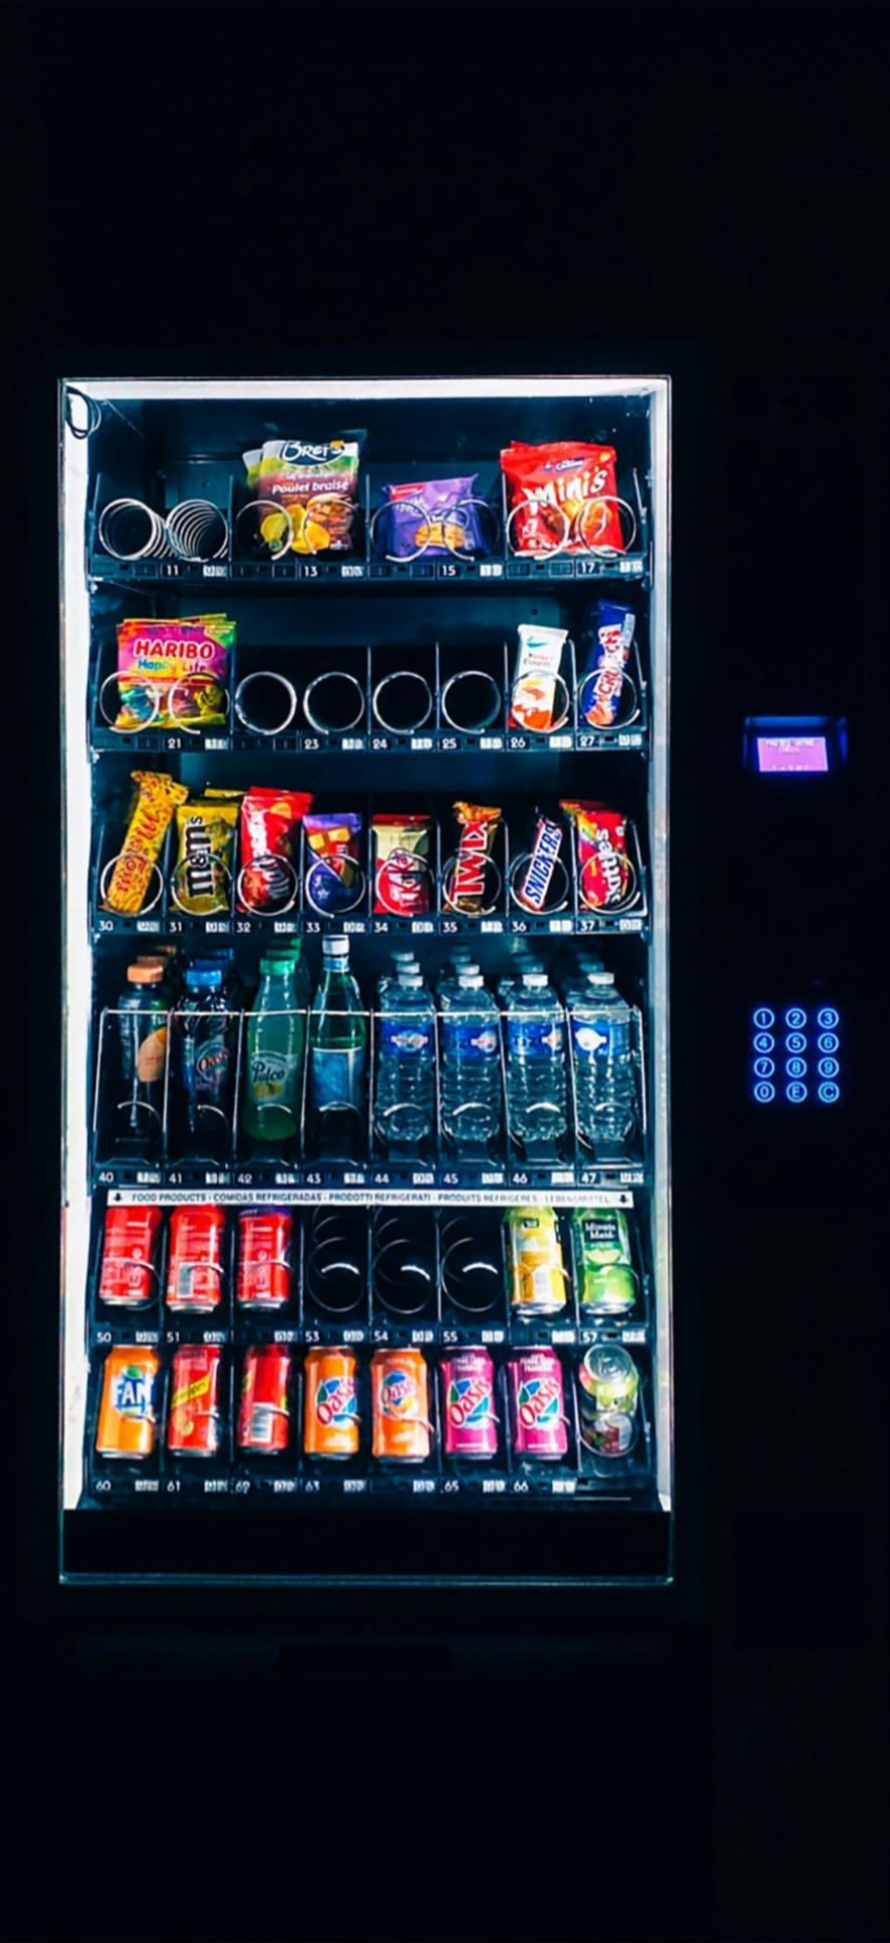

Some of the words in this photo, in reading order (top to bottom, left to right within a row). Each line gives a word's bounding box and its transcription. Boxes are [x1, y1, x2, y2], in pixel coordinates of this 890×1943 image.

[272, 482, 310, 495] Poulet
[167, 564, 179, 576] 11
[305, 565, 318, 577] 13
[443, 564, 456, 577] 15
[581, 560, 595, 574] 17
[134, 640, 215, 660] HARIBO
[138, 658, 176, 673] Happy
[168, 737, 181, 749] 21
[305, 738, 319, 750] 23
[373, 738, 388, 750] 24
[443, 737, 457, 750] 25
[511, 737, 526, 749] 26
[580, 735, 595, 748] 27
[450, 820, 487, 905] TWIX
[525, 823, 562, 904] SNICKERS
[98, 920, 114, 933] 30
[170, 921, 182, 933] 31
[237, 921, 251, 933] 32
[307, 921, 321, 933] 33
[375, 921, 389, 933] 34
[444, 921, 458, 933] 35
[513, 920, 527, 933] 36
[581, 920, 596, 933] 37
[761, 1012, 766, 1025] 1
[791, 1012, 801, 1025] 2
[824, 1012, 833, 1025] 3
[758, 1036, 768, 1049] 4
[791, 1036, 801, 1049] 5
[824, 1037, 833, 1049] 6
[252, 1060, 286, 1082] Pulco
[760, 1061, 768, 1074] 7
[791, 1061, 801, 1074] 8
[824, 1061, 833, 1074] 9
[791, 1085, 800, 1098] E
[823, 1085, 834, 1098] C
[99, 1171, 114, 1183] 40
[169, 1173, 182, 1184] 41
[238, 1173, 253, 1185] 42
[307, 1173, 322, 1184] 43
[375, 1173, 390, 1184] 44
[444, 1173, 459, 1185] 45
[513, 1173, 528, 1184] 46
[582, 1172, 597, 1185] 47
[132, 1193, 157, 1202] FOOD
[159, 1193, 206, 1202] PRODUCTS
[213, 1193, 253, 1202] COMIDAS
[256, 1193, 321, 1202] REFRIGERADAS
[328, 1193, 373, 1202] PRODOTTI
[375, 1193, 432, 1202] REFRIGERATI
[438, 1193, 481, 1202] PRODUITS
[97, 1331, 112, 1343] 50
[167, 1331, 180, 1343] 51
[306, 1330, 320, 1342] 53
[374, 1330, 389, 1342] 54
[444, 1330, 458, 1343] 55
[583, 1330, 598, 1344] 57
[449, 1379, 489, 1426] Oasis
[519, 1379, 559, 1427] Oasis
[96, 1479, 112, 1491] 60
[167, 1480, 181, 1492] 61
[445, 1480, 460, 1492] 65
[514, 1480, 529, 1492] 66
